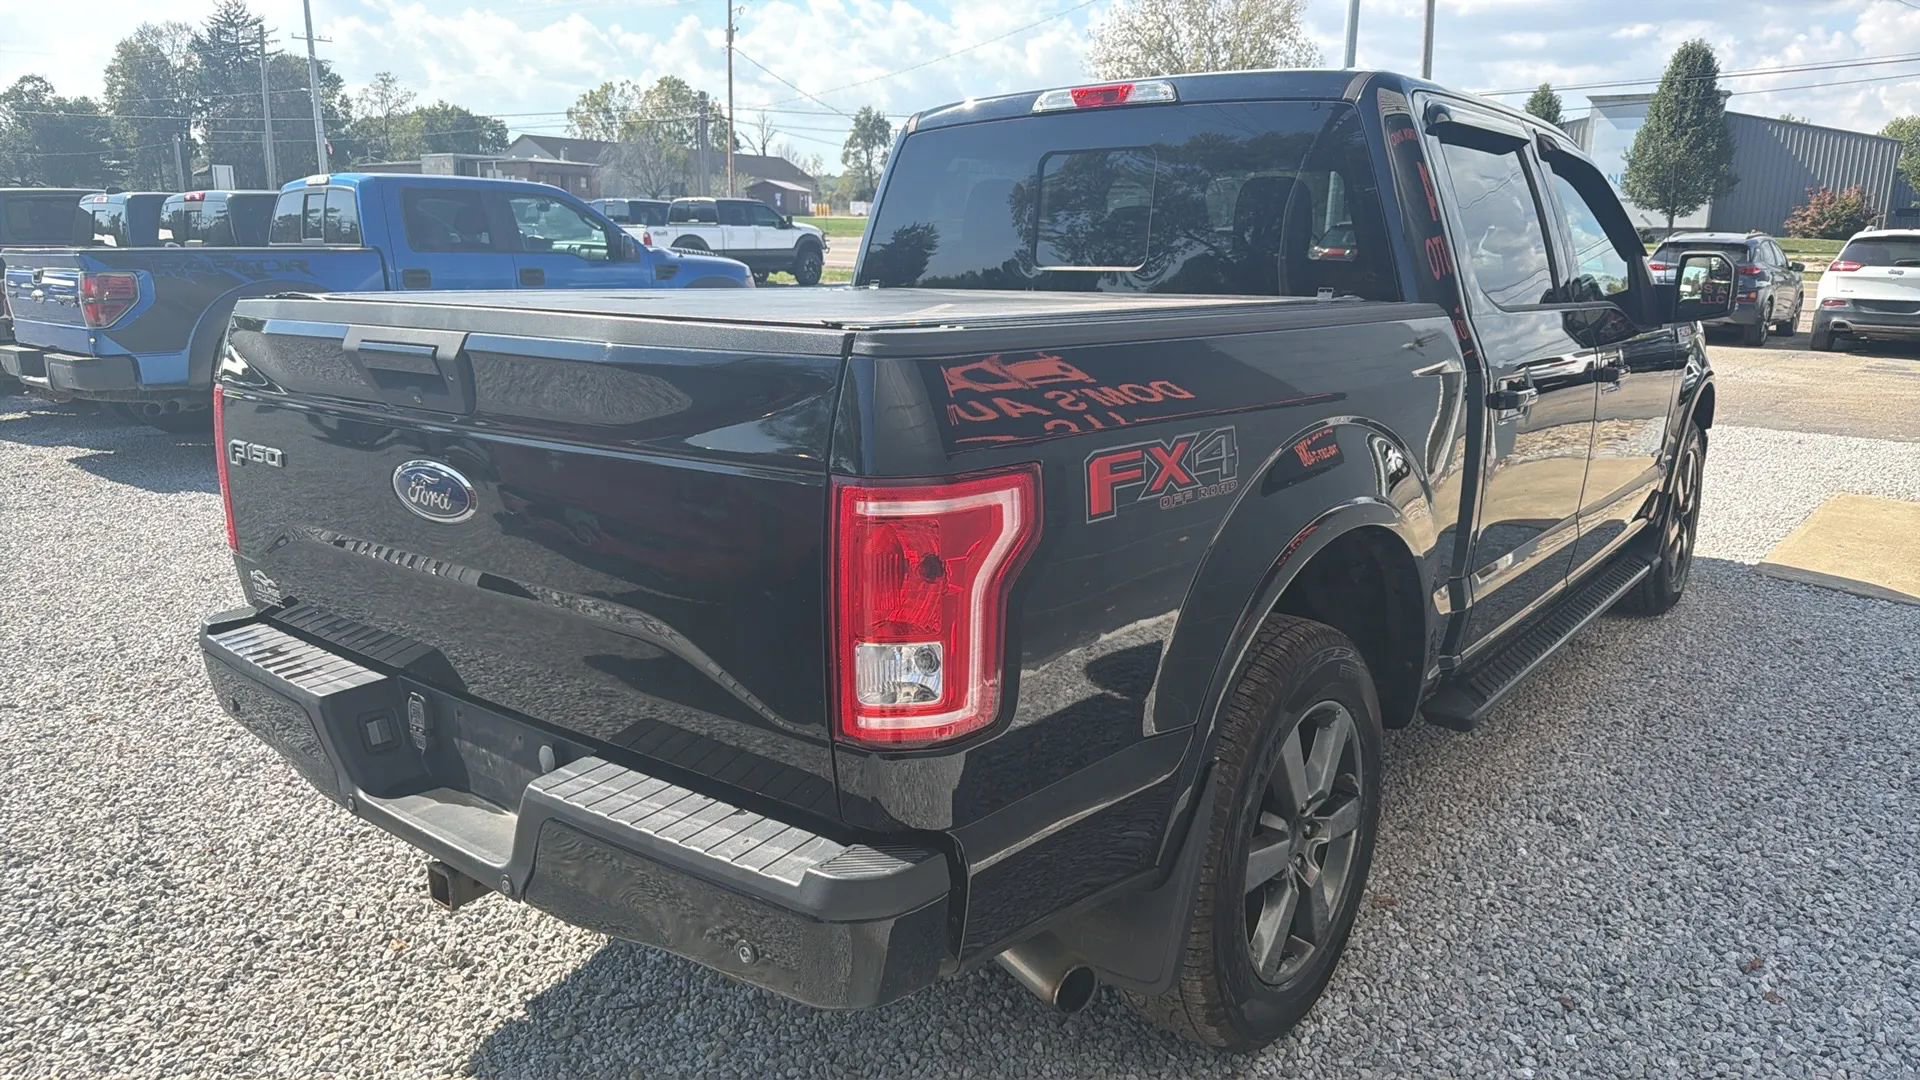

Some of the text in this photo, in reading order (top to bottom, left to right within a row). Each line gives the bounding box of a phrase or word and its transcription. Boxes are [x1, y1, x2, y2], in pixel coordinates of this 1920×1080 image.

[408, 472, 452, 511] Ford
[1084, 426, 1239, 524] FX4
[1159, 479, 1239, 510] OFF ROAD
